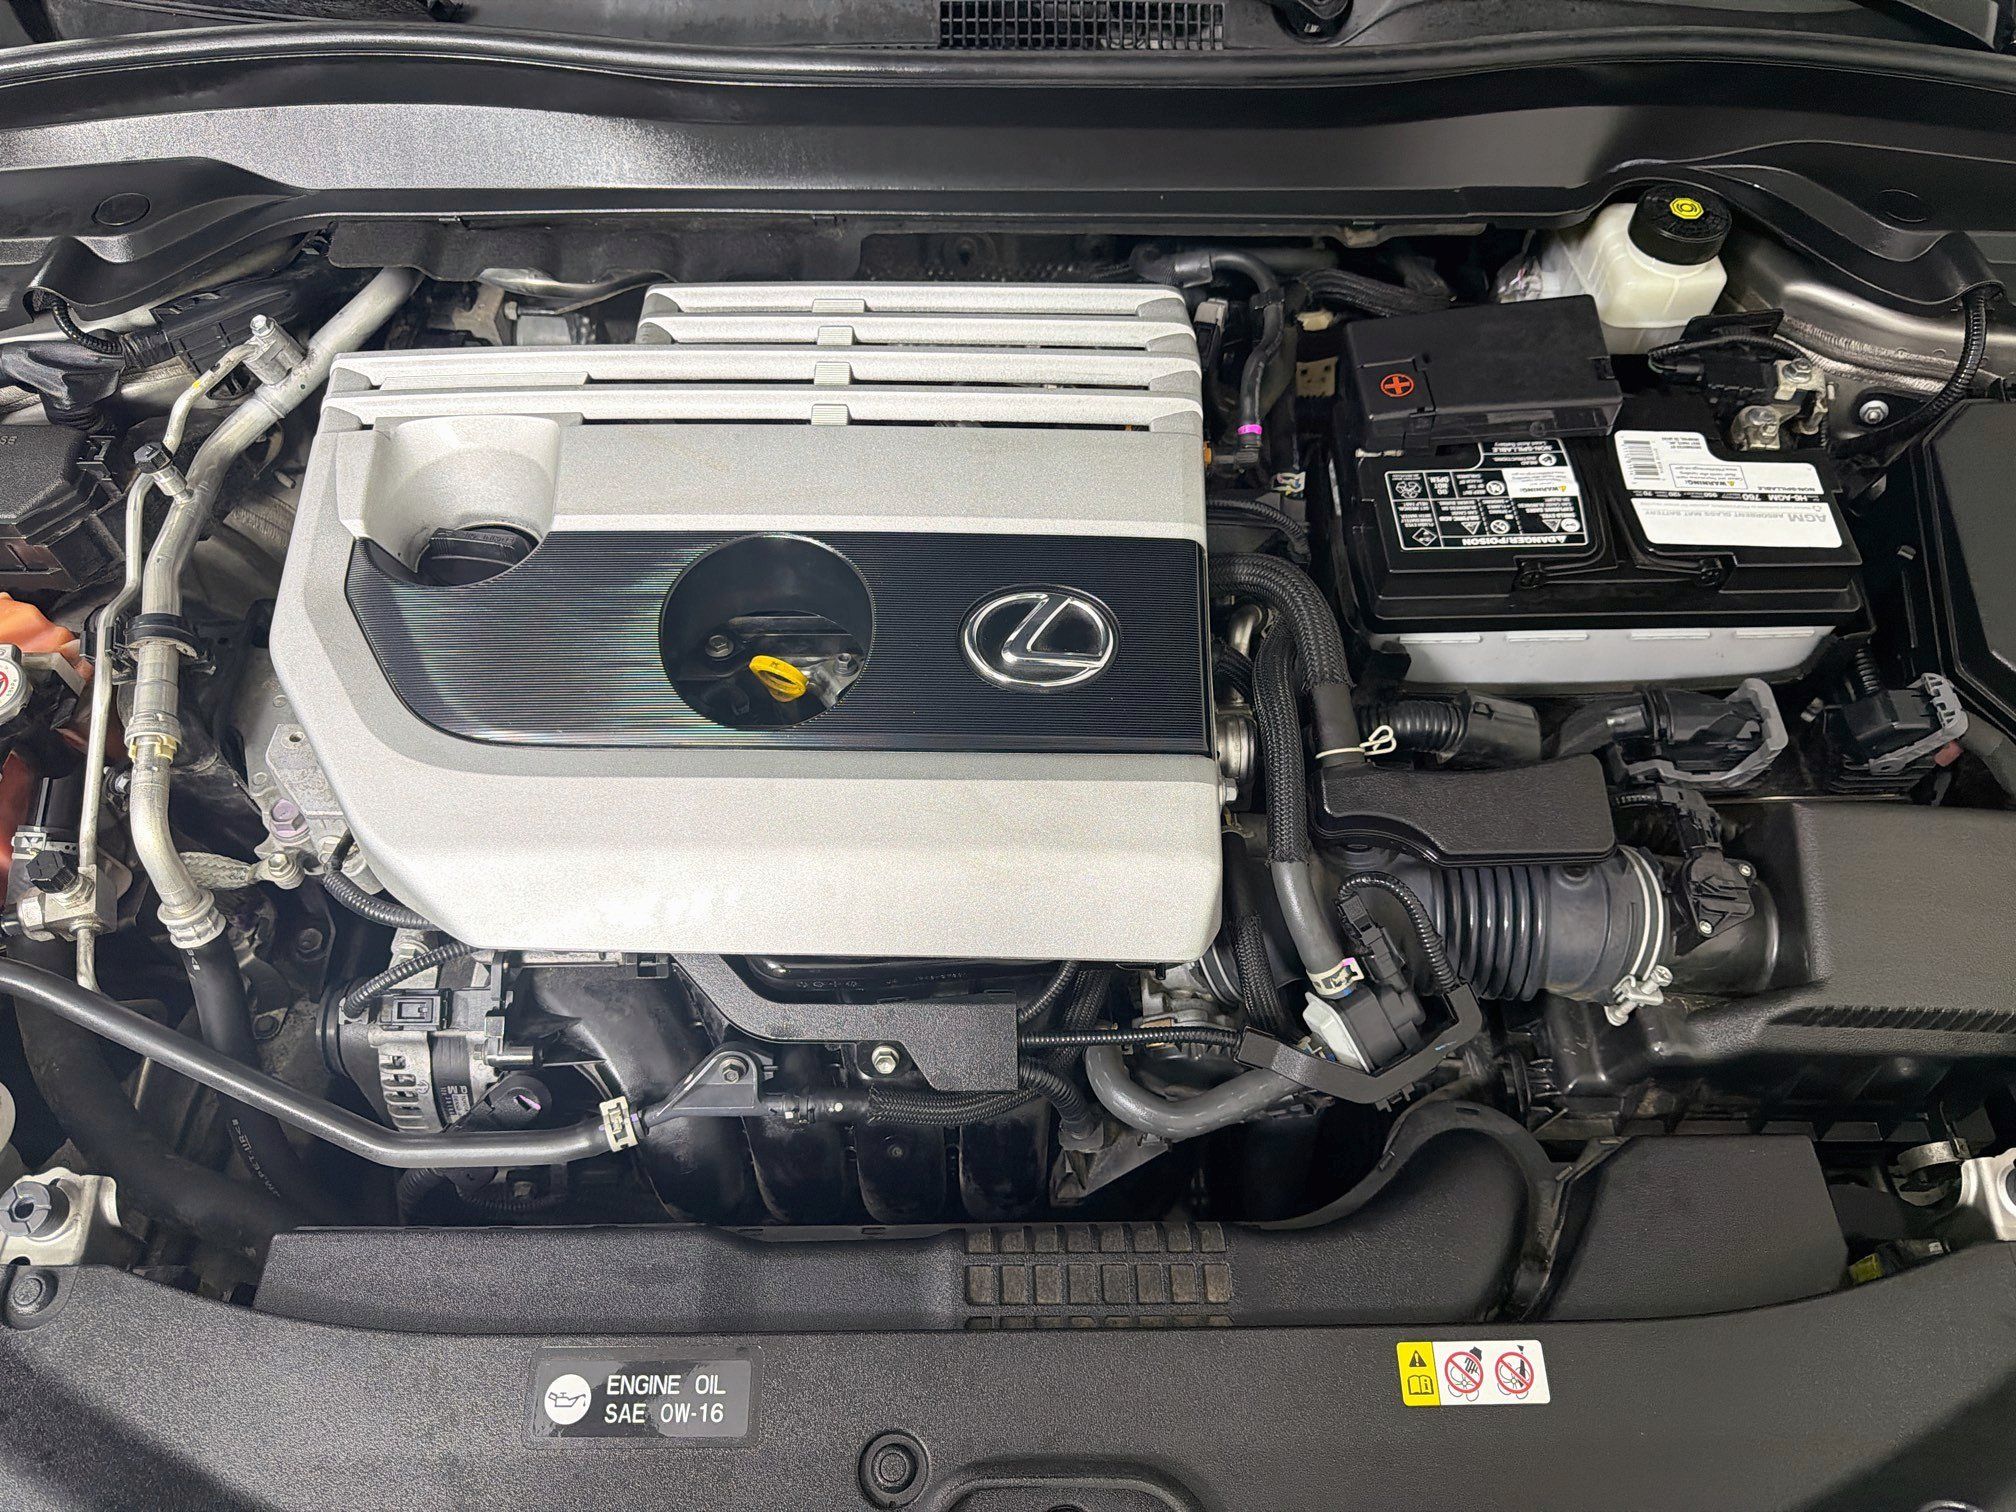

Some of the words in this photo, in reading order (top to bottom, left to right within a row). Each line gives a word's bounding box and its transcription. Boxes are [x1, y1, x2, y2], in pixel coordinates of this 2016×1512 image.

[1742, 493, 1761, 501] 760
[1787, 514, 1826, 522] AGM
[1462, 536, 1557, 545] DANGER/POISON
[606, 1374, 682, 1395] ENGINE
[694, 1374, 727, 1395] OIL
[604, 1403, 647, 1424] SAE
[660, 1402, 724, 1423] 0W-16
